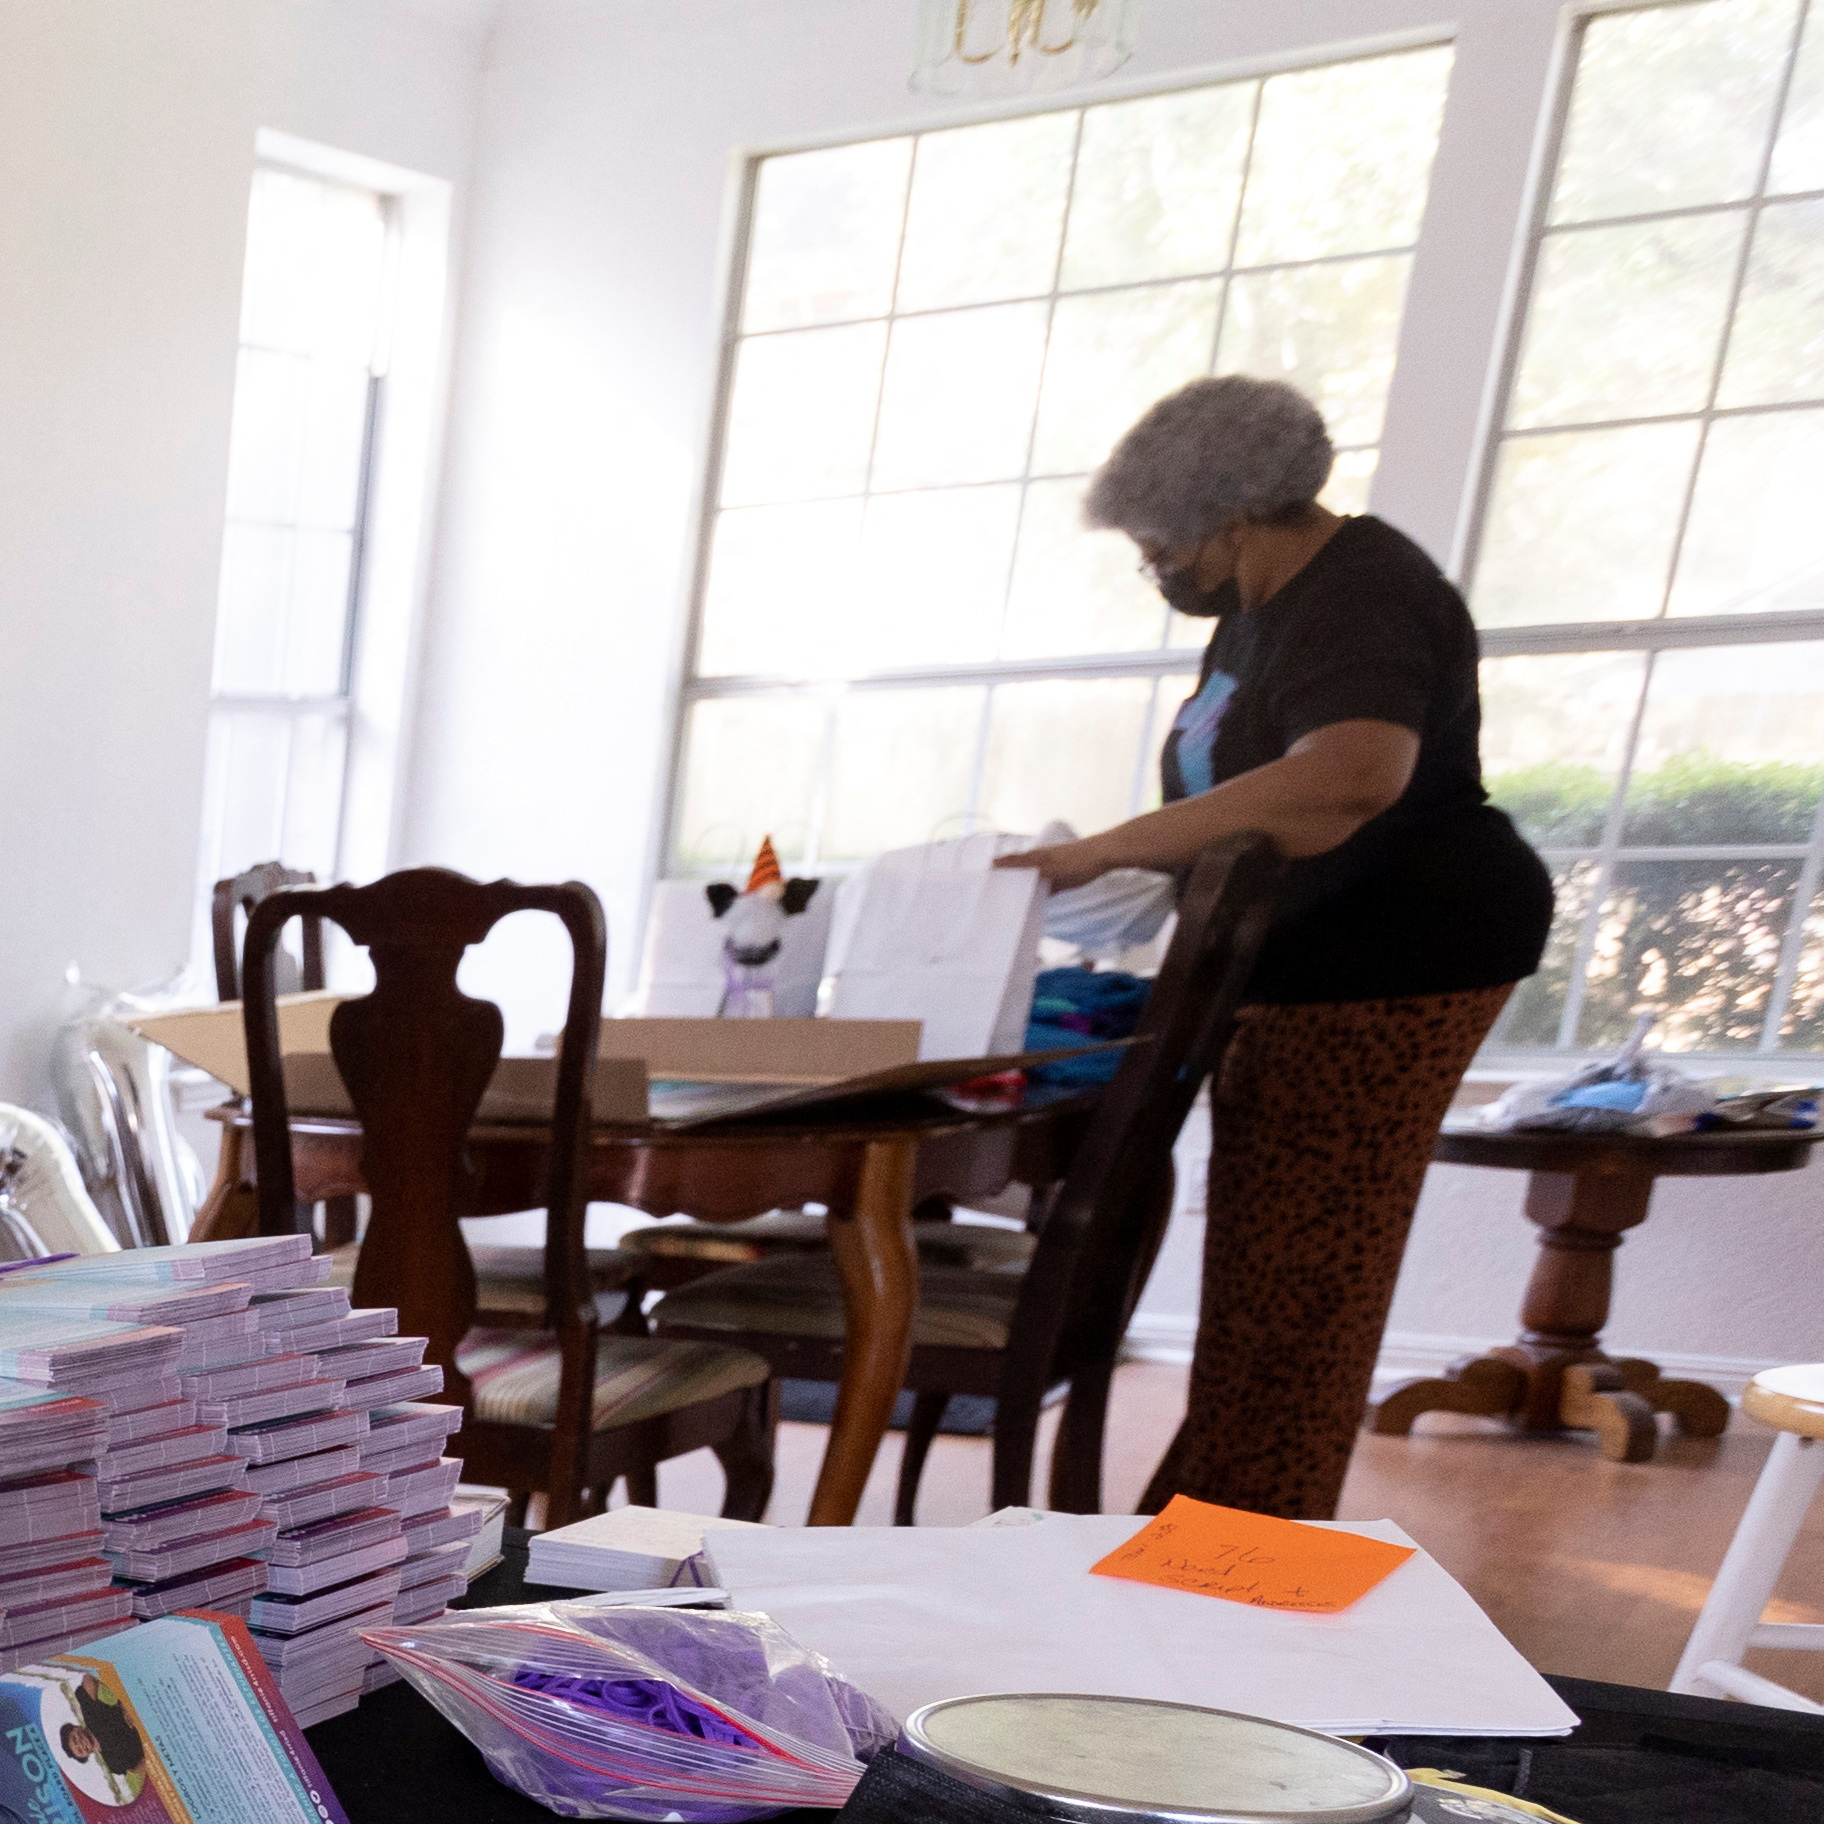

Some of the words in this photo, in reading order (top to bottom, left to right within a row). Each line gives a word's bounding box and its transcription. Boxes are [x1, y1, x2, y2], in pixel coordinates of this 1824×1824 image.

[215, 1634, 257, 1705] ESTUDIANTES
[254, 1708, 269, 1728] LOS
[34, 1737, 54, 1769] PLACE
[153, 1734, 175, 1767] METAS
[266, 1731, 290, 1768] TODOS
[51, 1770, 74, 1807] BOARD
[175, 1776, 202, 1820] LOGROS
